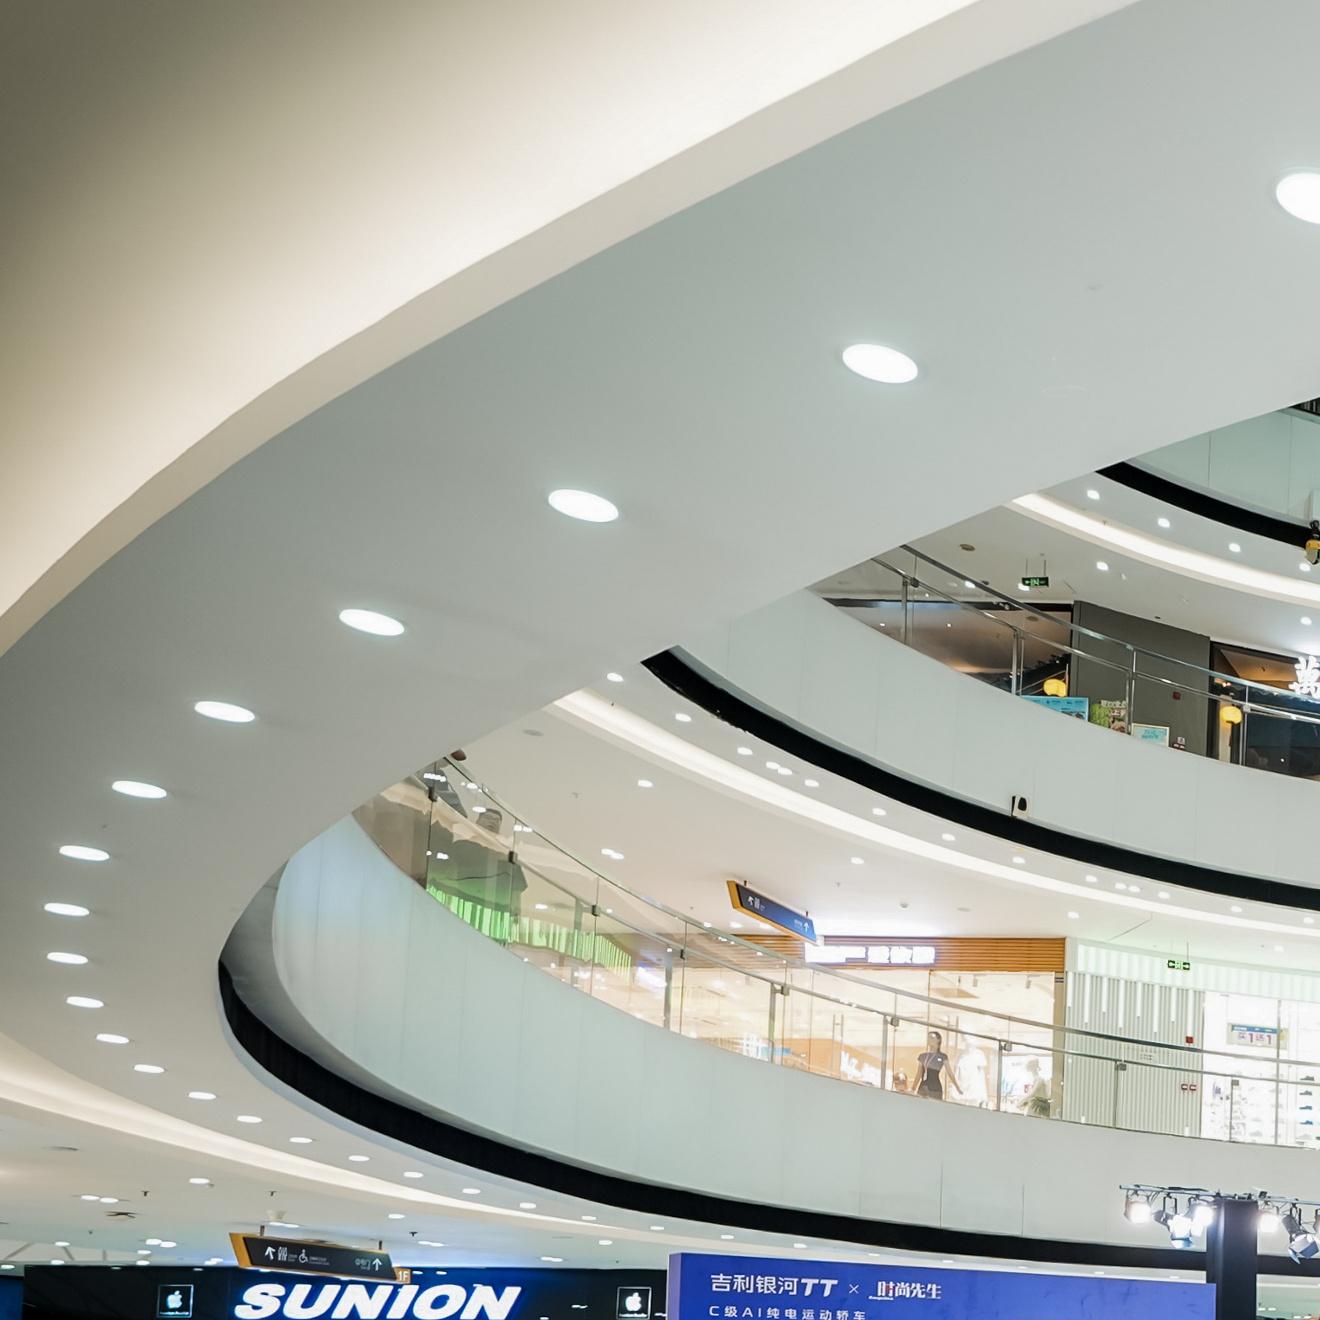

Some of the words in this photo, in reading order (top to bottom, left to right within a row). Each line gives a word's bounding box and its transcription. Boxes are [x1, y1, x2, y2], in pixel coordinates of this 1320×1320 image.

[398, 1270, 409, 1282] 1F
[710, 1273, 839, 1298] 吉利银河TT
[877, 1280, 942, 1300] 时尚先生
[234, 1282, 523, 1320] SUNION
